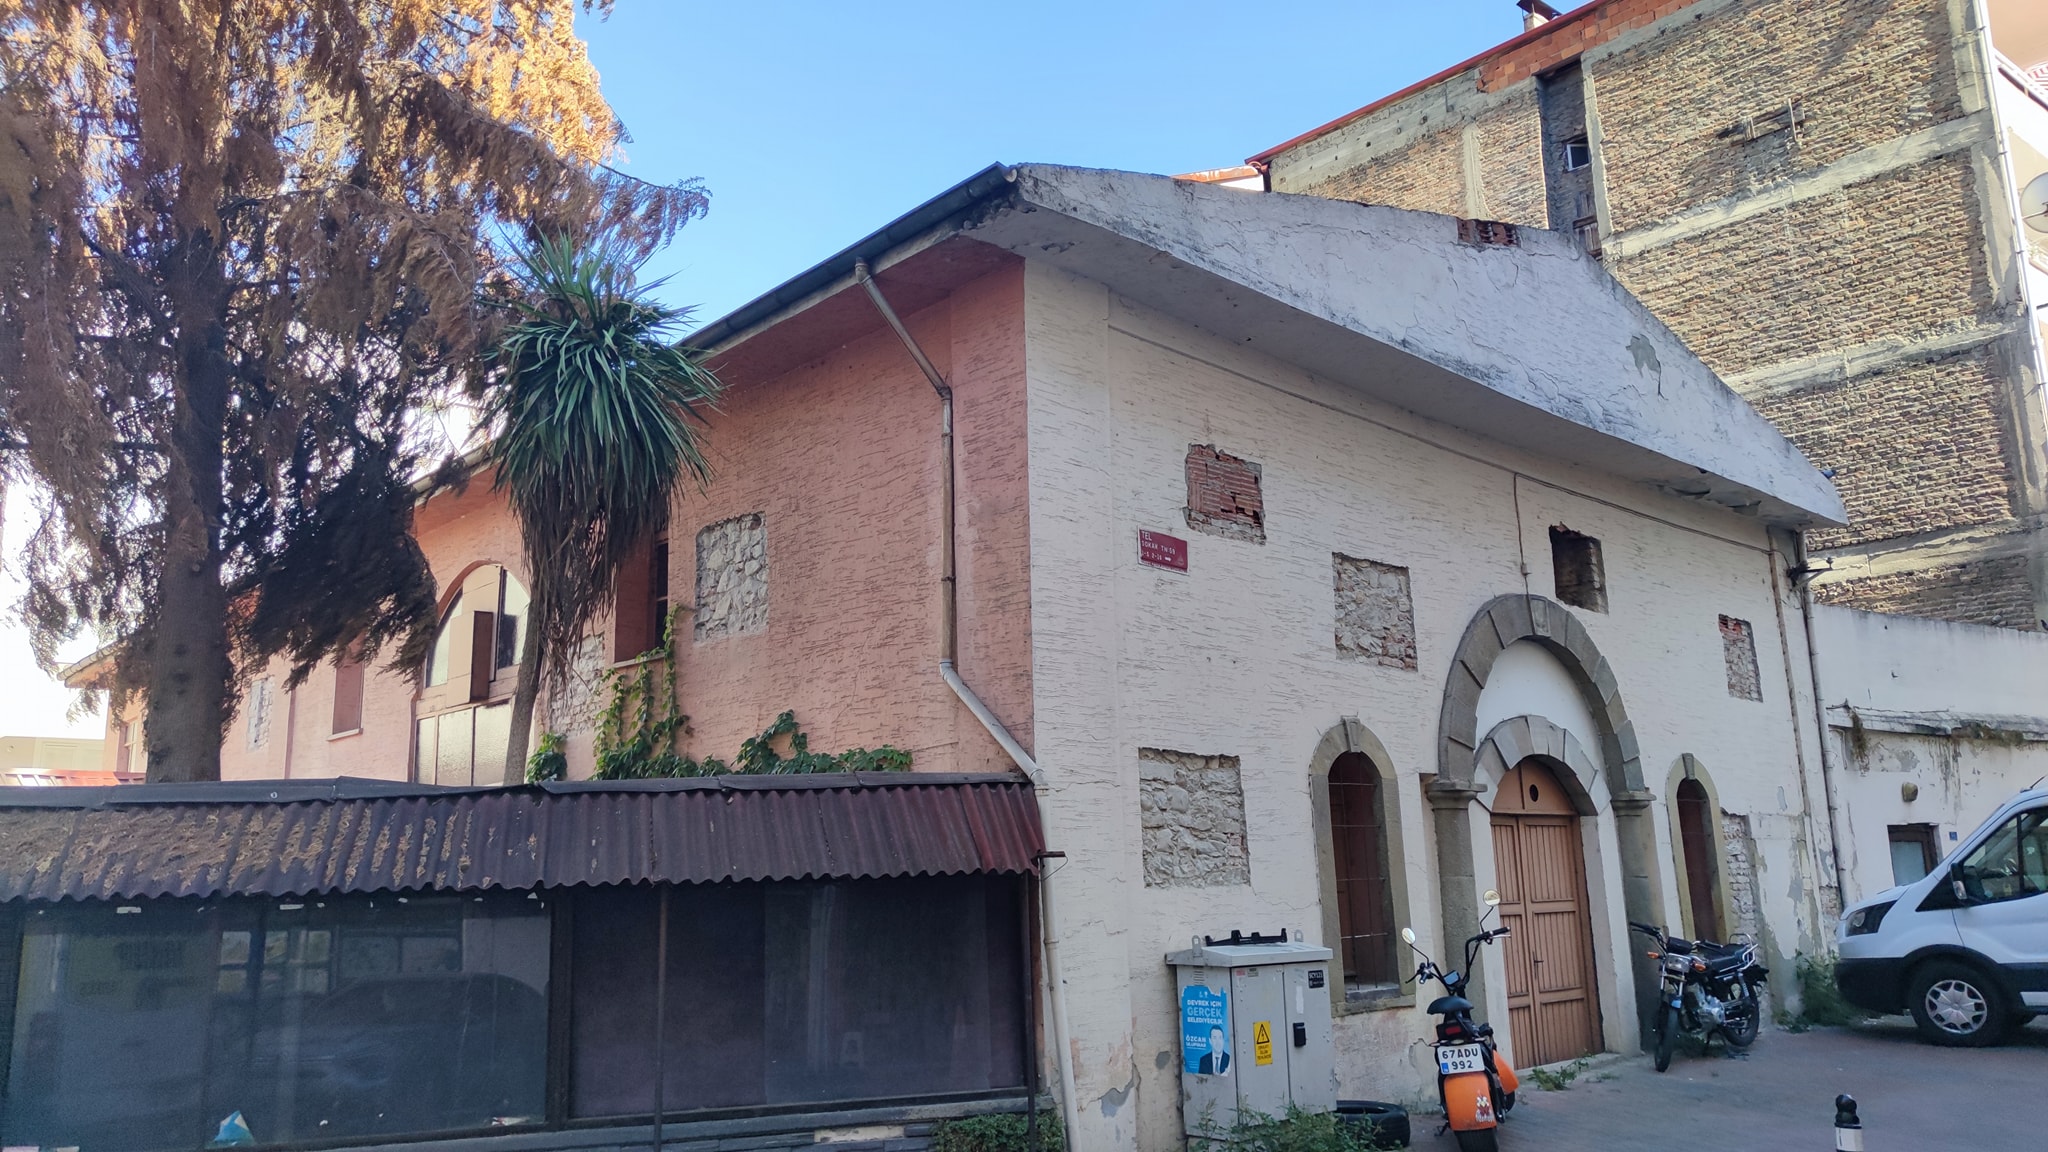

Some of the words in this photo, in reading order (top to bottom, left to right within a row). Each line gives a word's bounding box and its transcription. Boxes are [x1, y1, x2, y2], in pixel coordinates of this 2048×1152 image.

[1141, 531, 1152, 541] TEL
[1187, 1006, 1223, 1018] GERÇEK
[1185, 1034, 1206, 1042] ÖZCAN
[1451, 1060, 1473, 1070] 992
